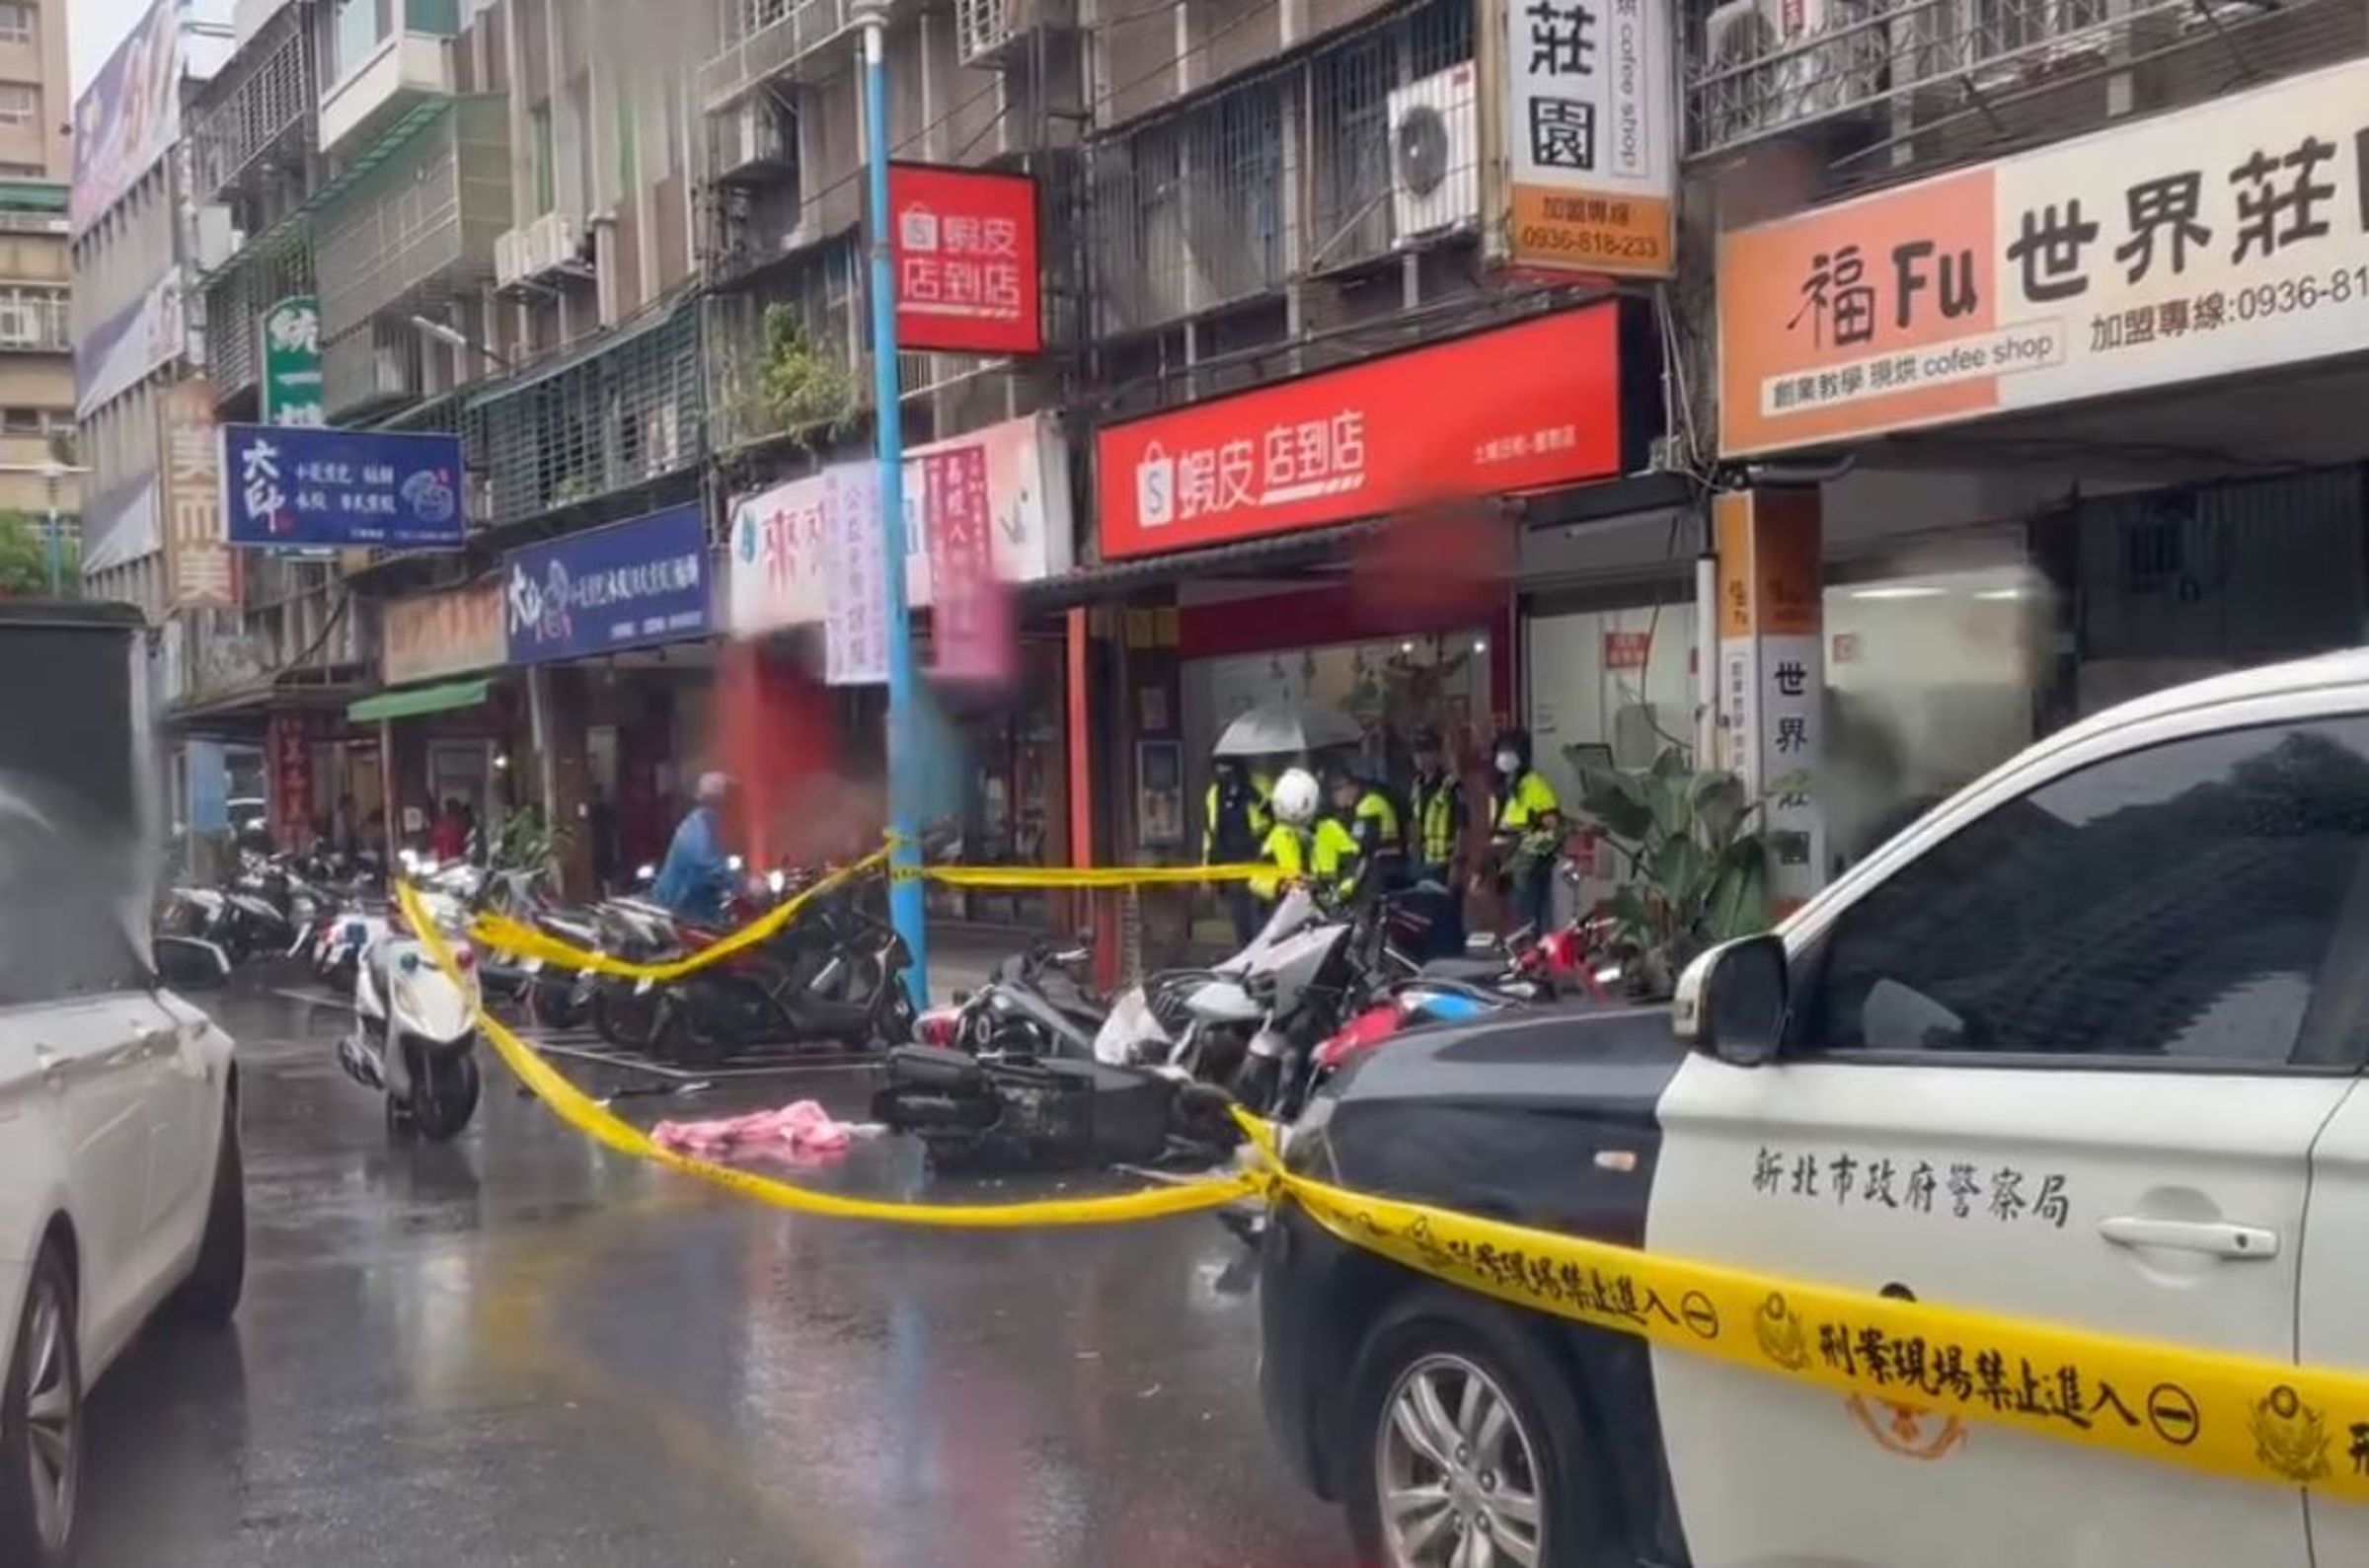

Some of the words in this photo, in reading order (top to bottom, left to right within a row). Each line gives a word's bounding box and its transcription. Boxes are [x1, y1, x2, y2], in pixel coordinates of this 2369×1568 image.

[1620, 102, 1638, 167] shop
[943, 216, 1018, 258] 蝦皮
[1523, 226, 1659, 259] 0936-818-233
[1787, 243, 1876, 351] 福
[1891, 240, 1977, 328] Fu
[2006, 126, 2369, 303] 世界莊
[903, 259, 1021, 306] 店到店
[1924, 346, 1985, 377] cofee
[1993, 336, 2054, 365] shop
[1179, 439, 1258, 520] 蝦皮
[1263, 409, 1364, 485] 店到店
[1751, 1145, 2070, 1229] 新北市政府警察局
[1818, 1323, 2141, 1430] 刑案現場禁止進入
